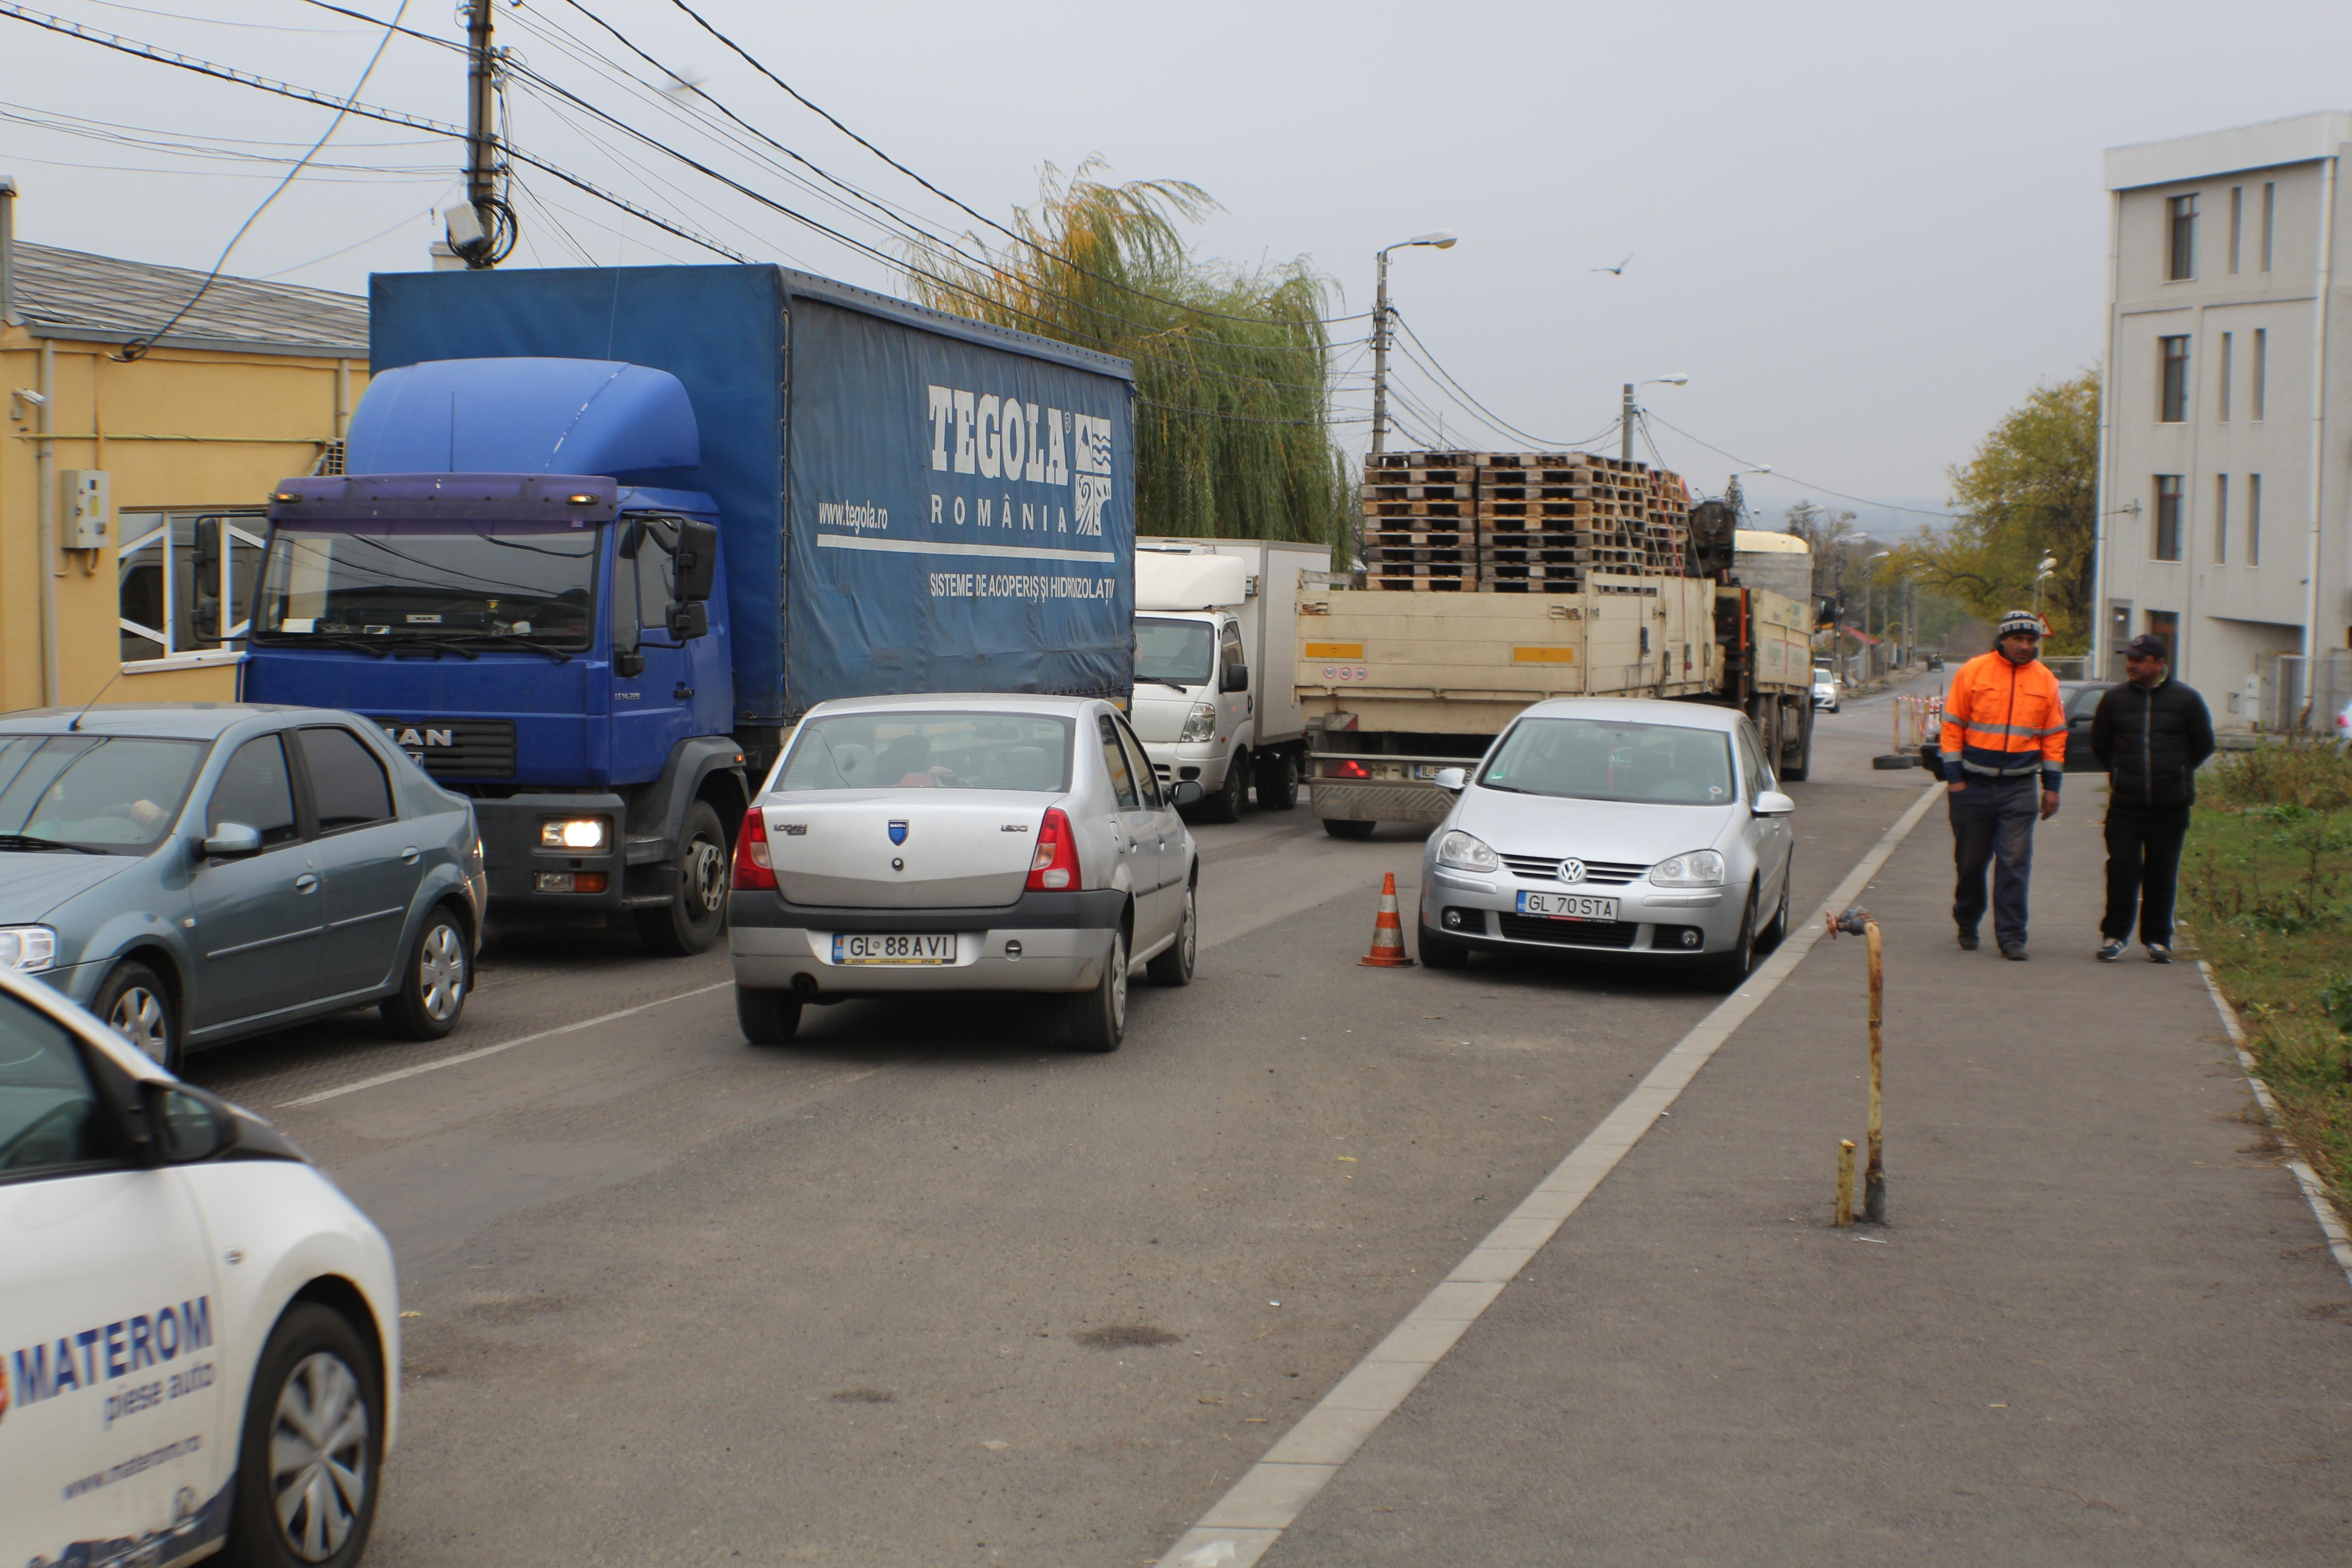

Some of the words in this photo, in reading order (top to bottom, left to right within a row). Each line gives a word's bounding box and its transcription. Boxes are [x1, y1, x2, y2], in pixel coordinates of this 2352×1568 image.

[929, 385, 1068, 485] TEGOLA
[819, 499, 887, 535] www.tegola.ro
[930, 573, 973, 597] SISTEME
[976, 574, 987, 597] DE
[1529, 895, 1549, 912] GL
[1558, 897, 1577, 913] 70
[1581, 899, 1612, 916] STA
[850, 937, 876, 956] GL
[885, 936, 909, 956] 88
[912, 936, 947, 956] AVI
[11, 1294, 215, 1408] MATEROM
